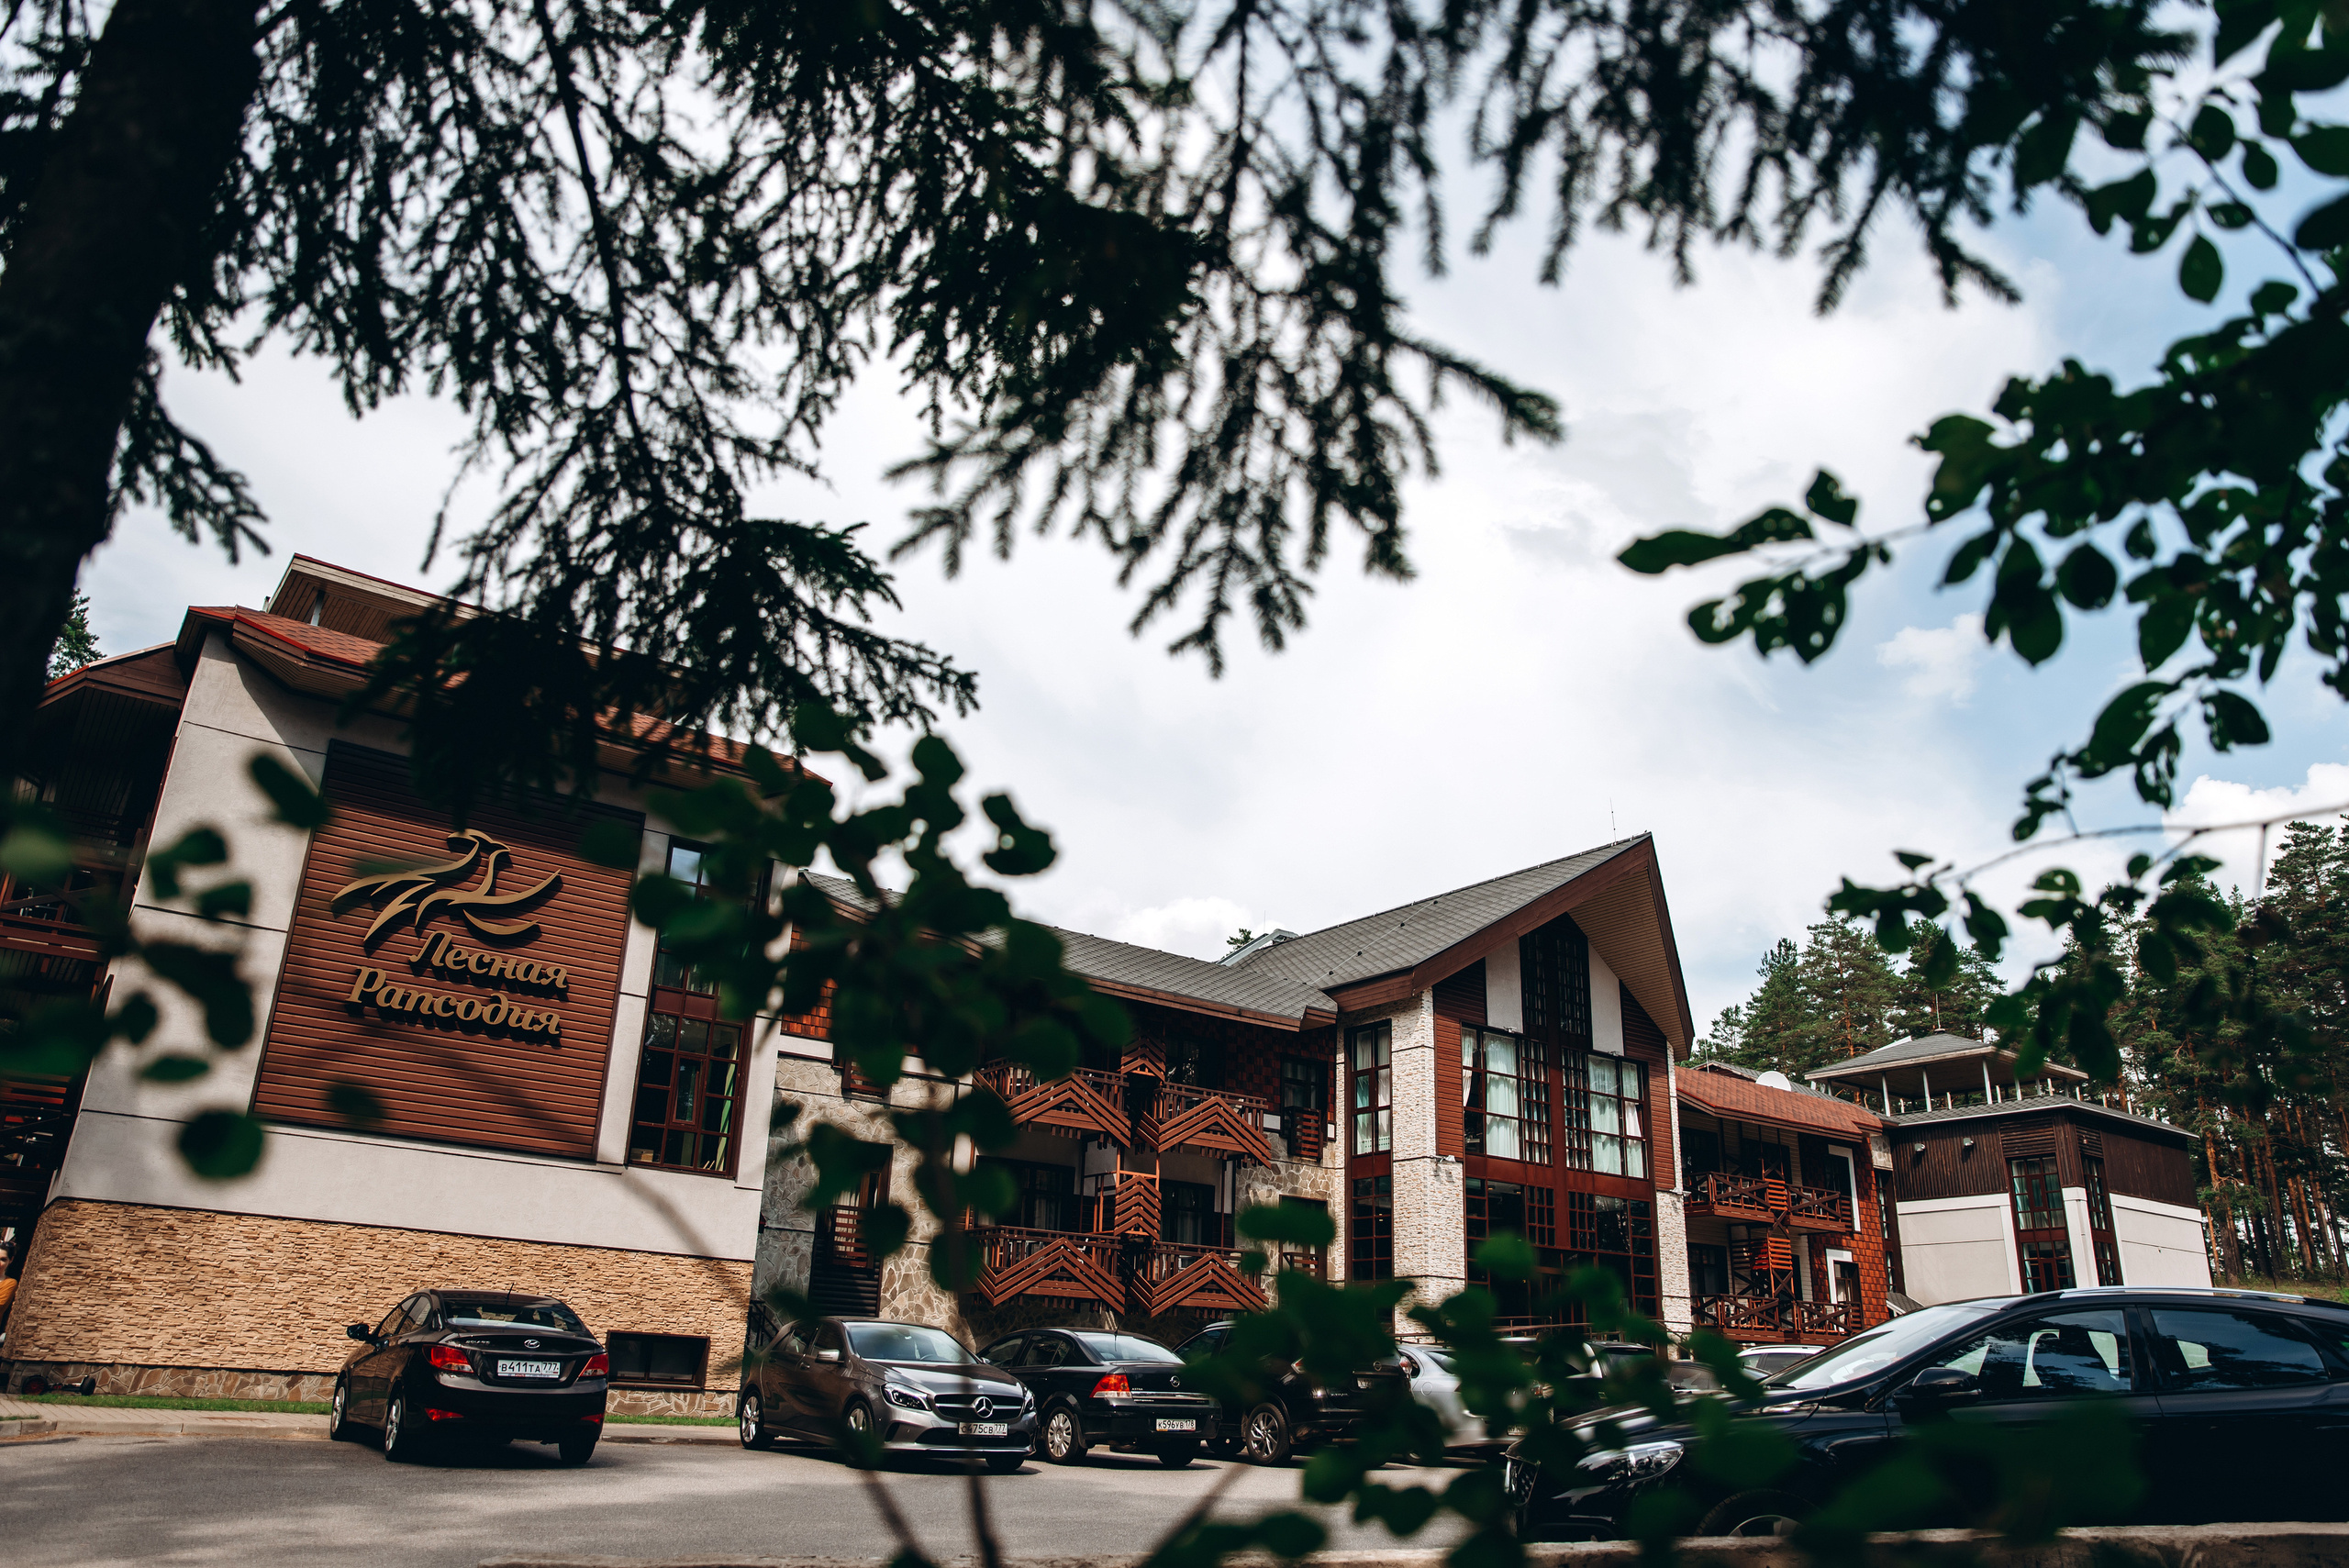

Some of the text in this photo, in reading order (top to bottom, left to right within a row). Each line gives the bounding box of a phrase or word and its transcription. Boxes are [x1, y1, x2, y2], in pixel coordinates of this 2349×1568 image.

[409, 930, 568, 989] Лесная
[345, 966, 561, 1035] Рапсодия
[501, 1362, 558, 1373] В411ТА 777
